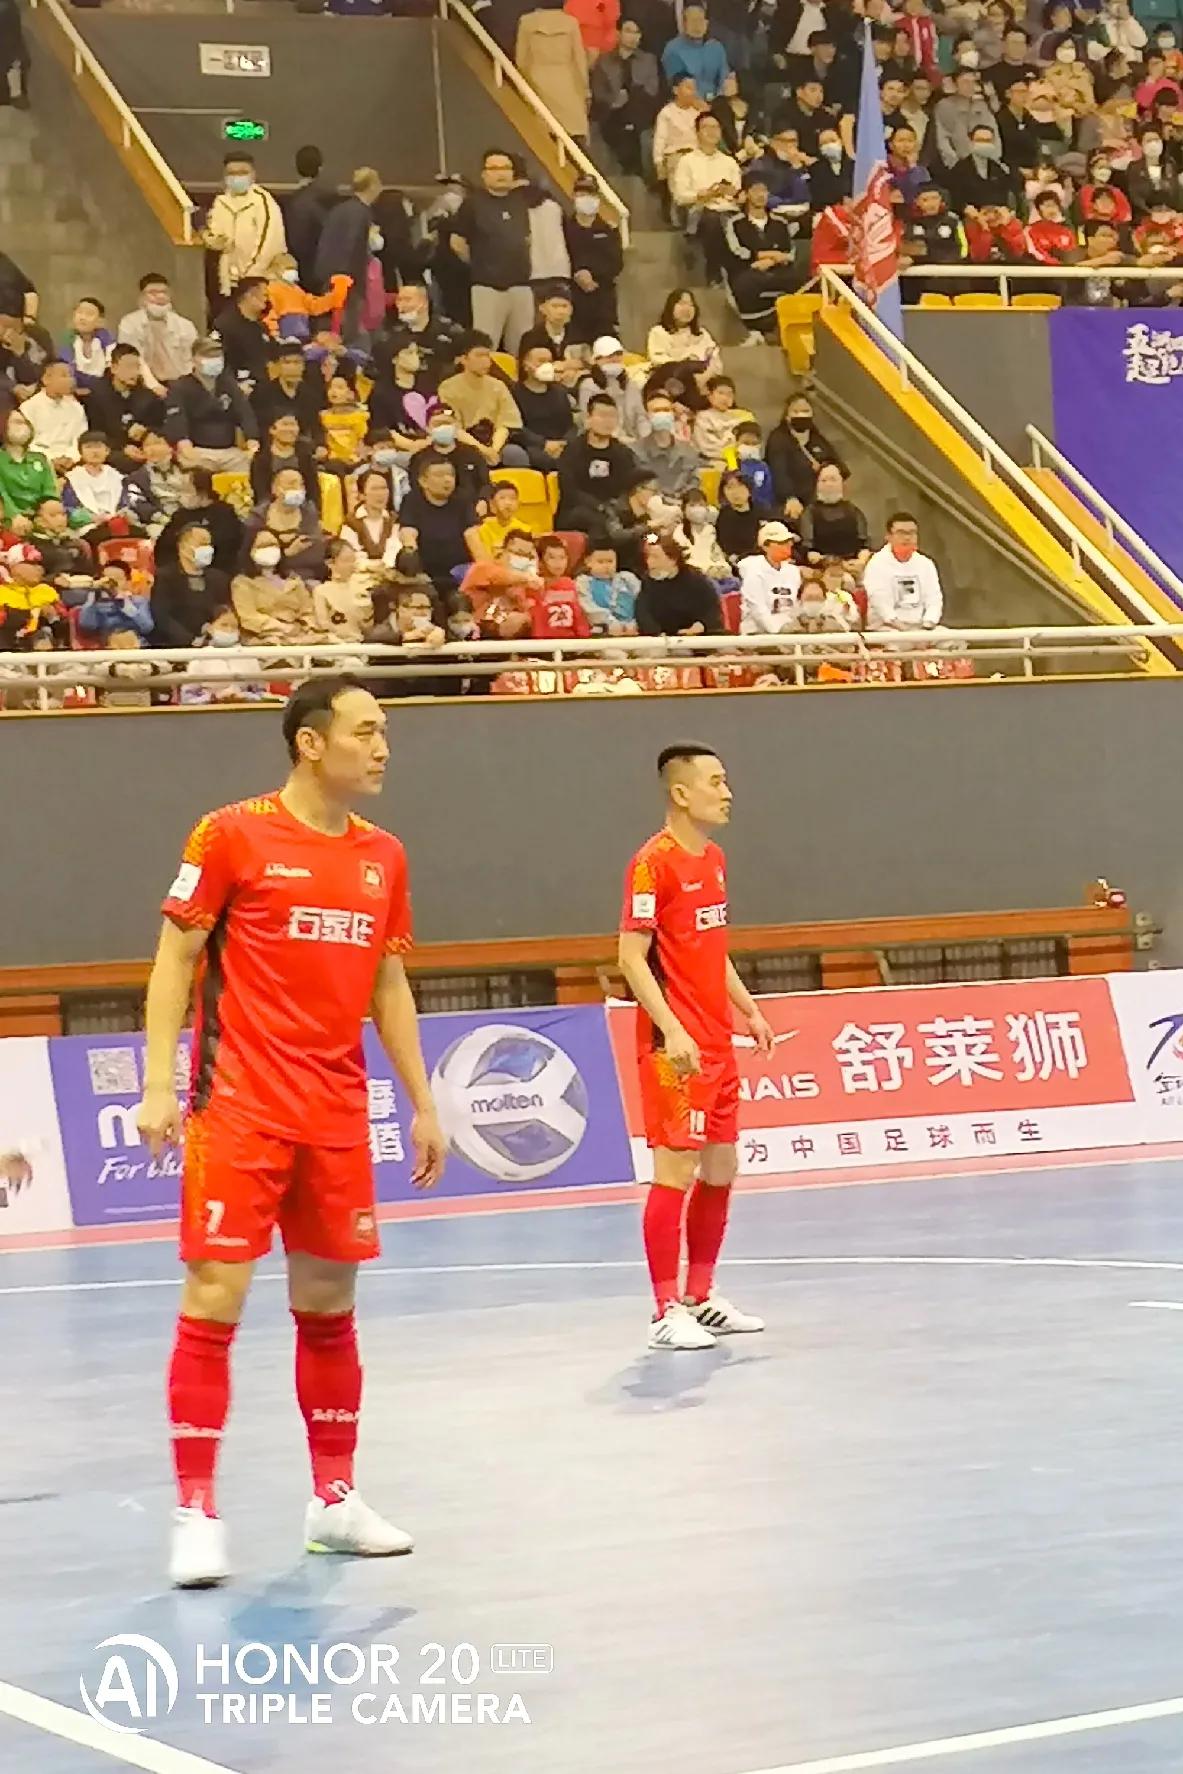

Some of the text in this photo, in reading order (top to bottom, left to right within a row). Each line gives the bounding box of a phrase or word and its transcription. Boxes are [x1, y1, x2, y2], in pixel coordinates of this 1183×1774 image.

[831, 1010, 1090, 1095] 舒莱狮
[470, 1092, 544, 1114] molten
[745, 1119, 1043, 1164] 为中国足球而生
[97, 1155, 146, 1185] For
[205, 1200, 225, 1235] 7
